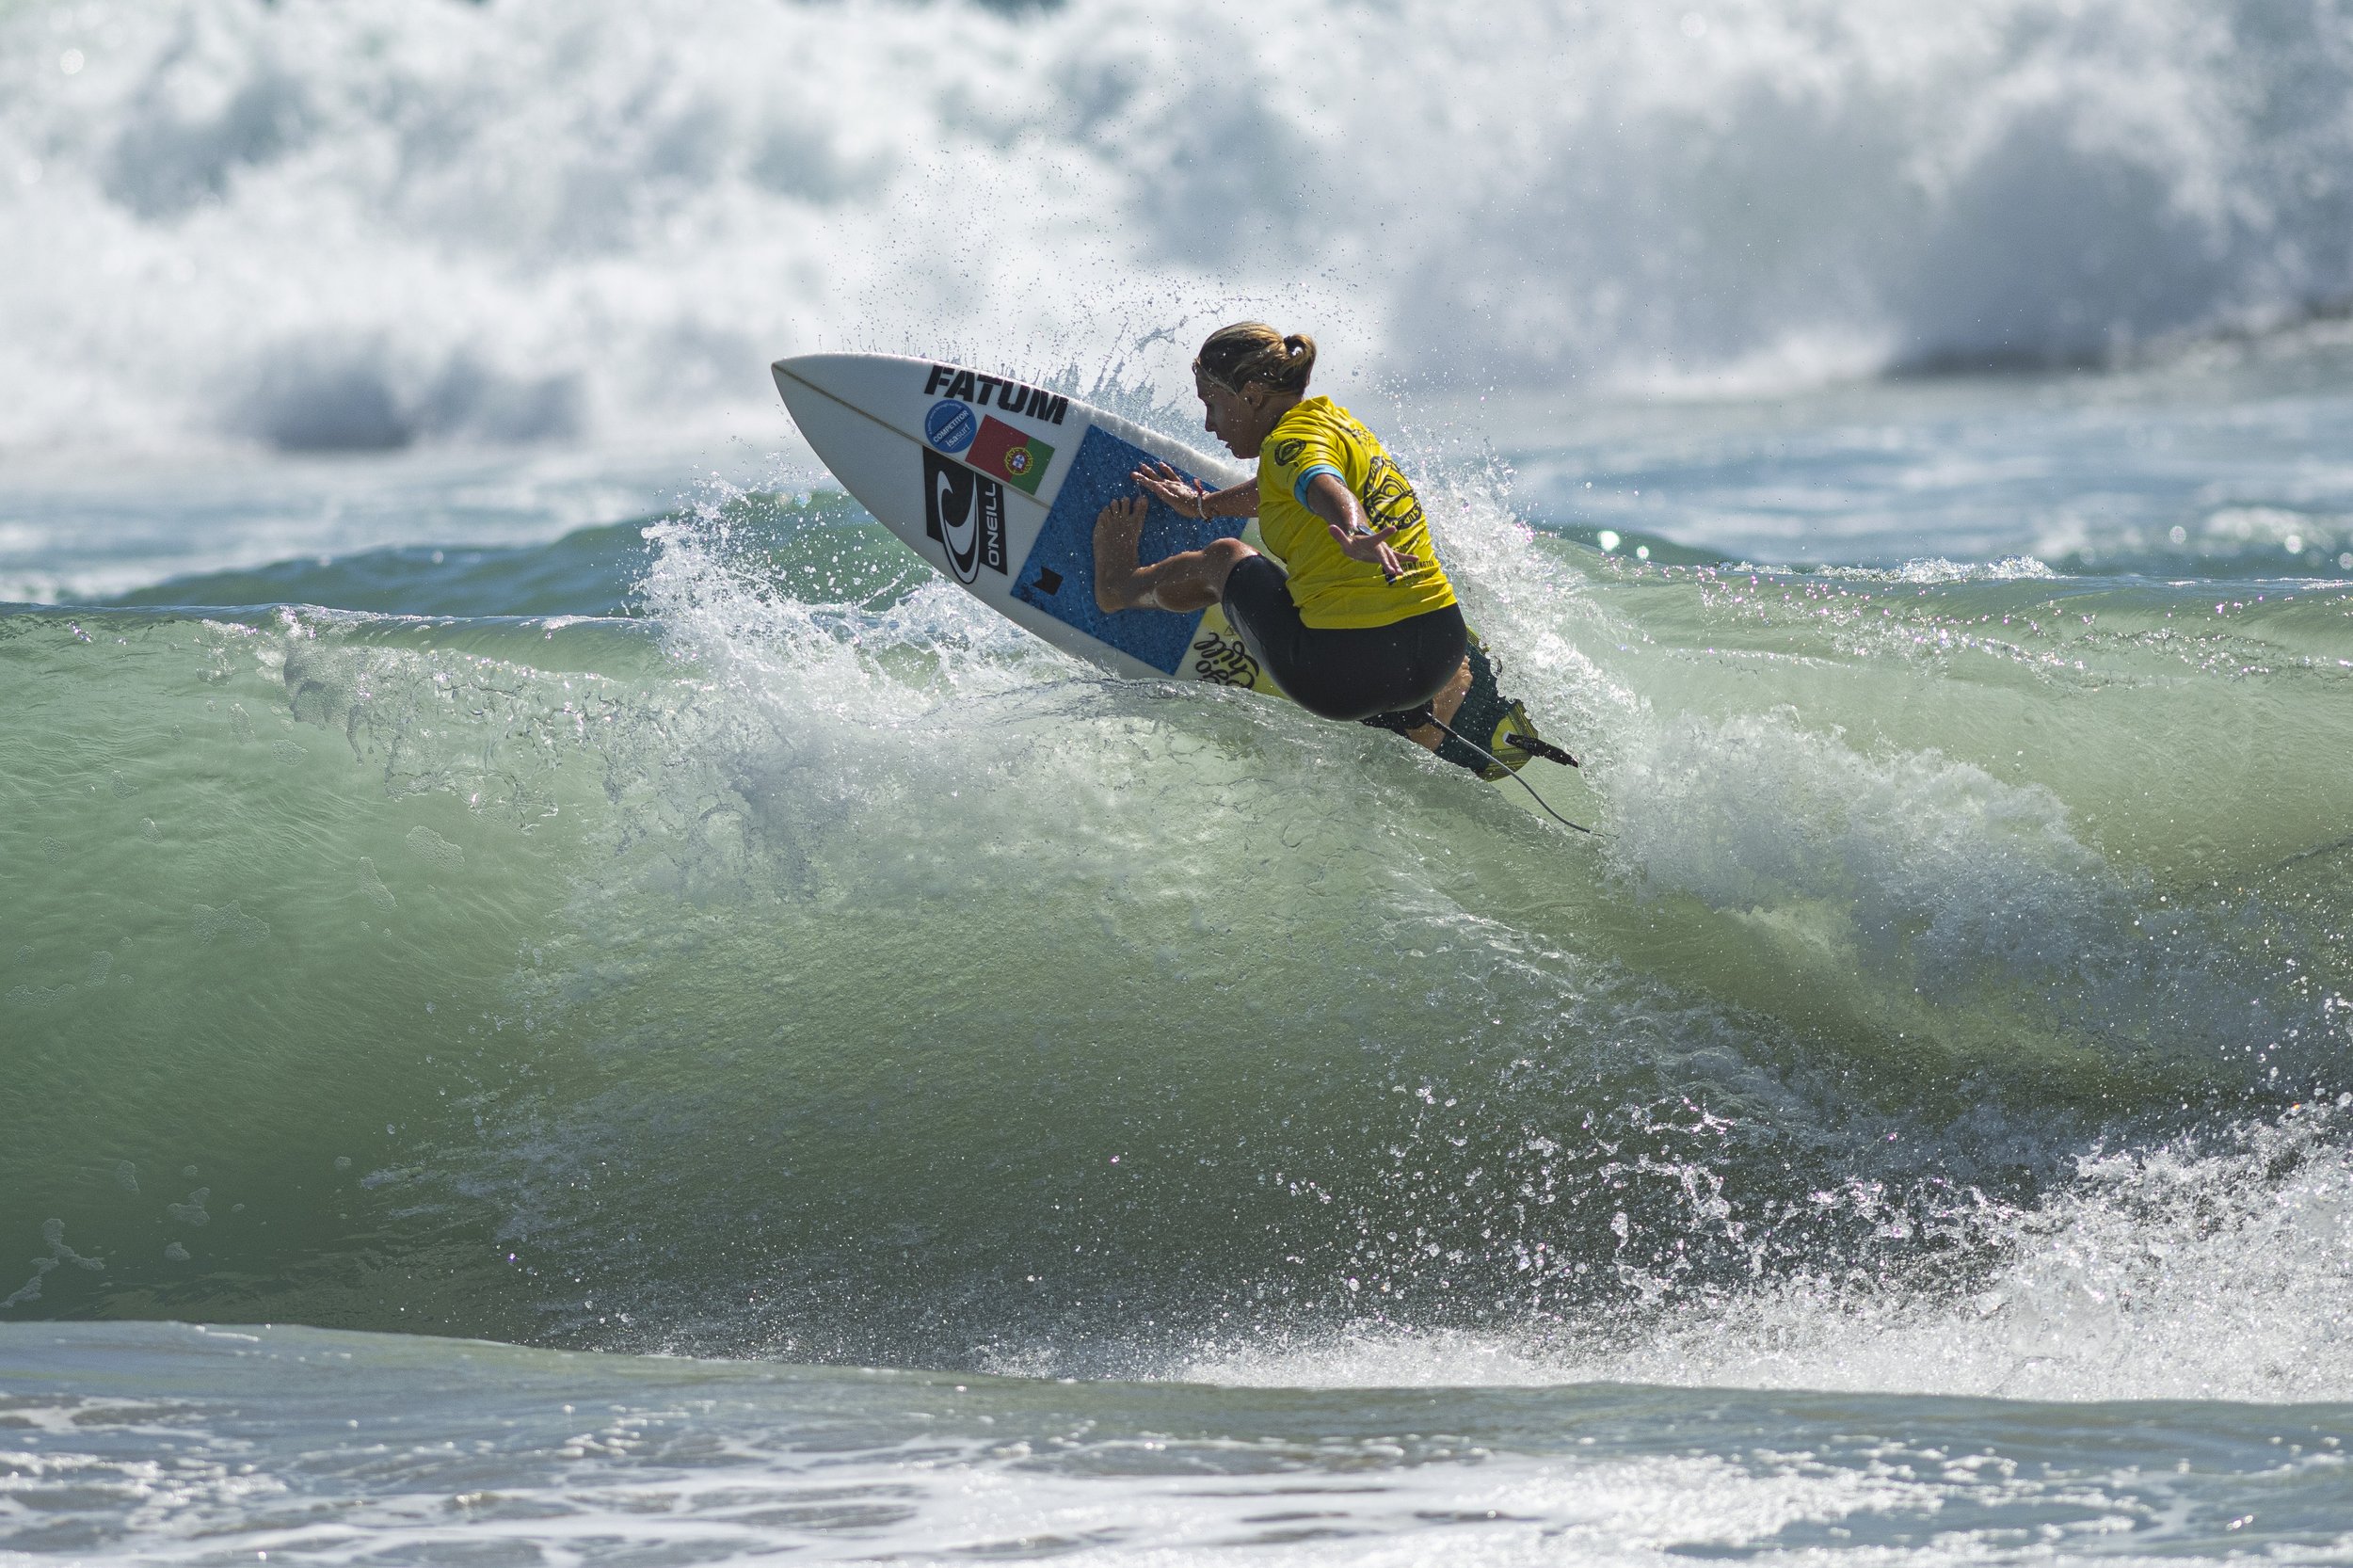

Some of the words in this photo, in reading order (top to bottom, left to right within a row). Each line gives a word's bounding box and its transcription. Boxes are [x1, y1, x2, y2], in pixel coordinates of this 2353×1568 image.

[923, 365, 1069, 425] FATUM
[933, 409, 969, 442] COMPETITOR
[945, 423, 970, 447] isasurf
[984, 483, 1000, 567] O'NEILL
